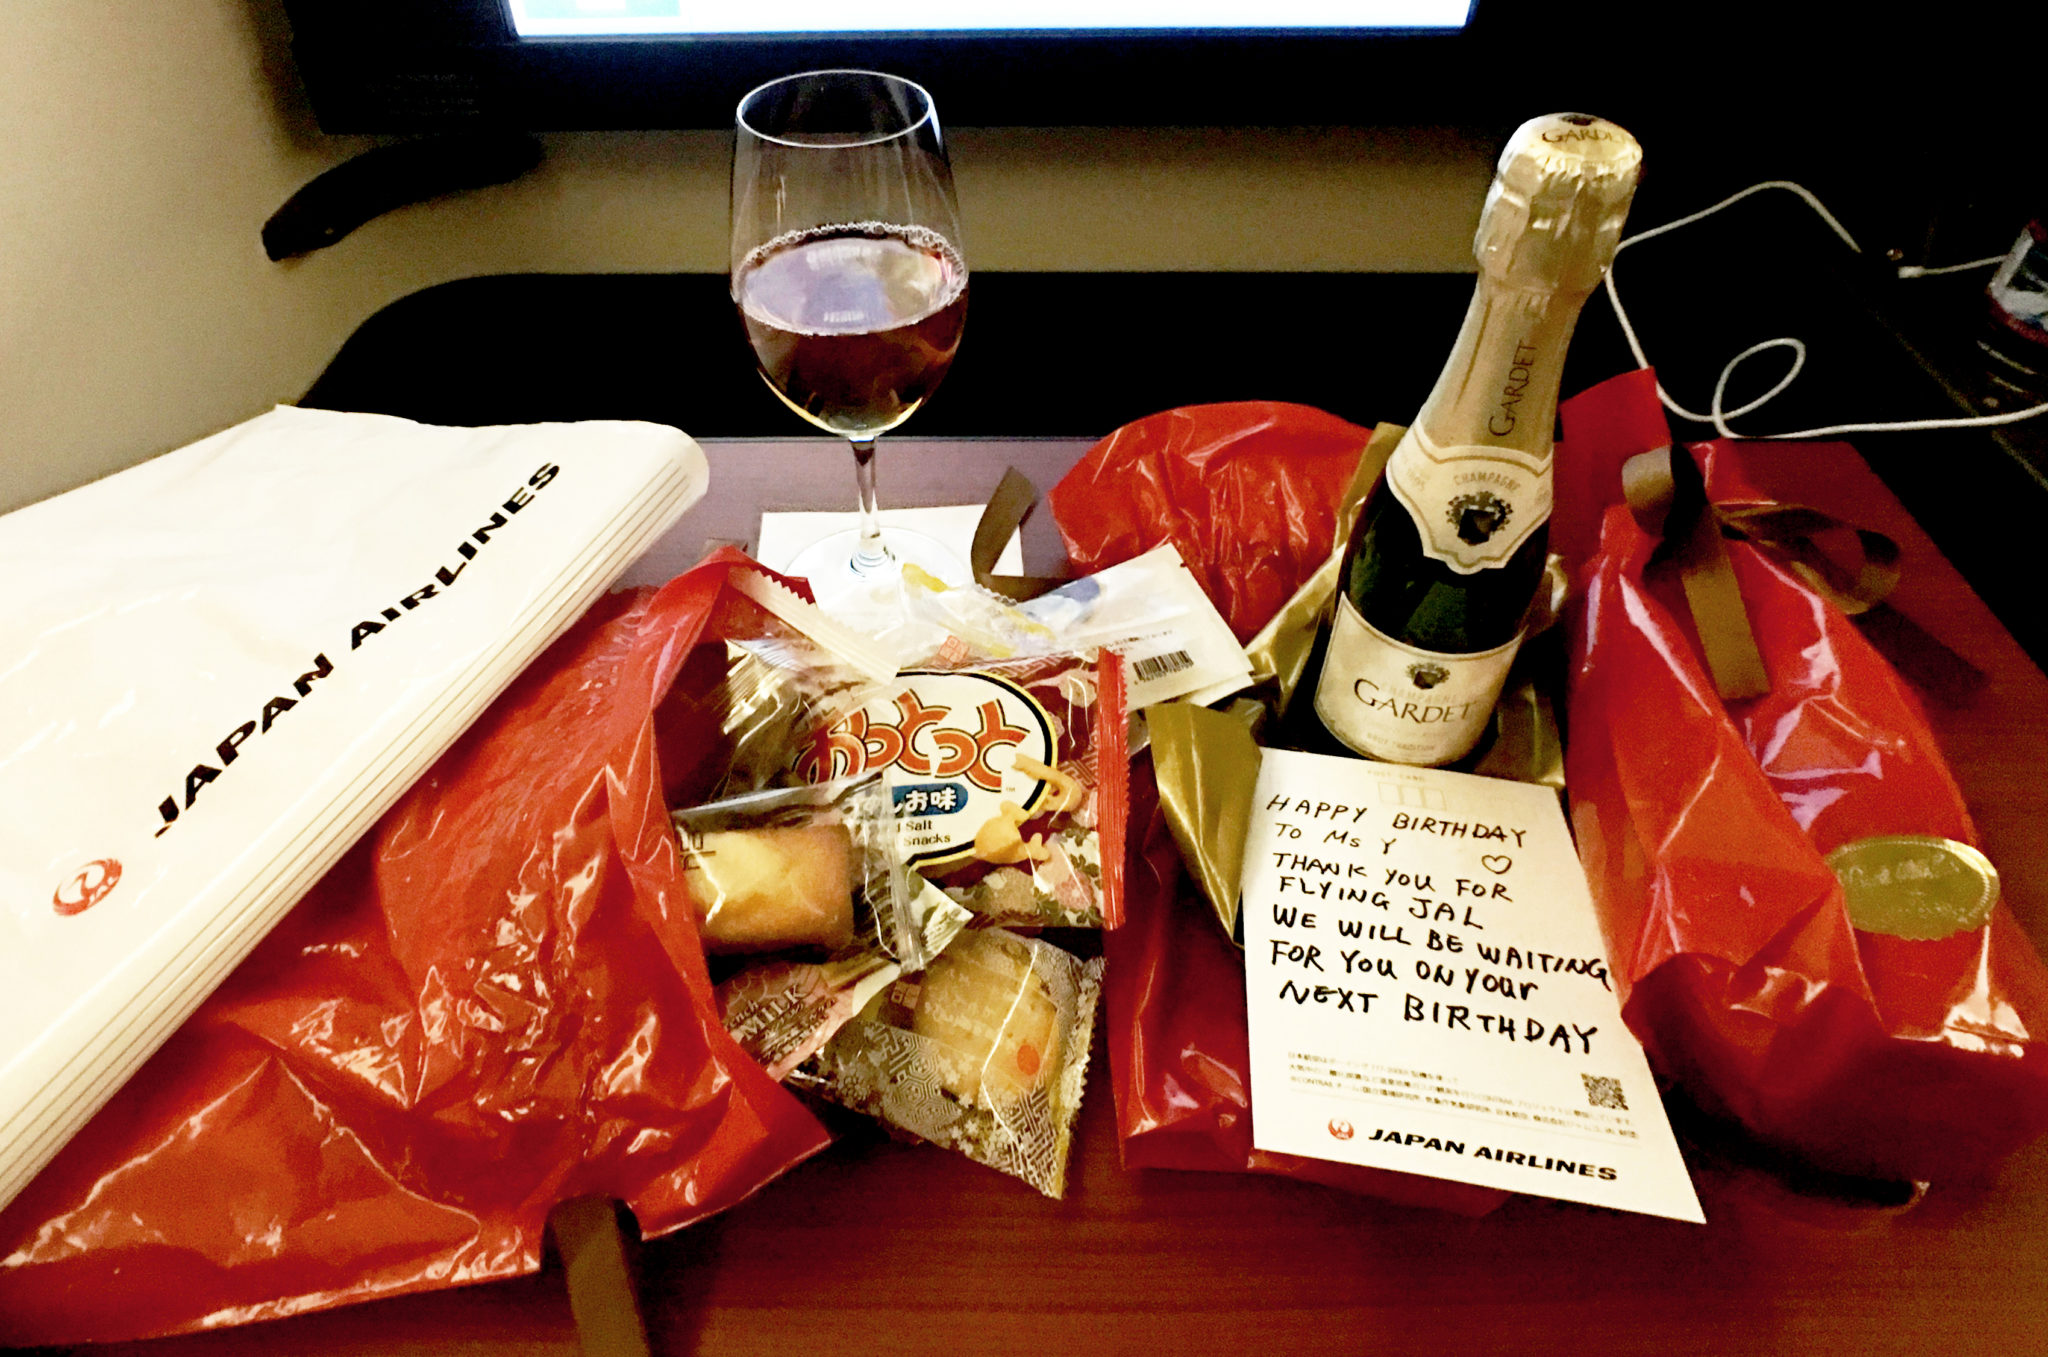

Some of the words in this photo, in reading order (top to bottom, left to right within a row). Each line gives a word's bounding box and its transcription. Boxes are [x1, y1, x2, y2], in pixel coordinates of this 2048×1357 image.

[1488, 339, 1538, 437] GARDET
[1453, 469, 1521, 491] CHAMPAGNE
[155, 652, 334, 838] JAPAN
[351, 462, 560, 651] AIRLINES
[1353, 678, 1478, 724] GARDET
[904, 832, 951, 847] Snacks
[905, 819, 933, 832] Salt
[1265, 794, 1368, 823] HAPPY
[1393, 812, 1527, 848] BIRTHDAY
[1274, 823, 1302, 840] TO
[1380, 837, 1397, 855] Y
[1273, 852, 1367, 878] THANK
[1455, 878, 1513, 902] FOR
[1279, 876, 1389, 910] FLYING
[1408, 897, 1484, 930] JAL
[1270, 939, 1325, 972] FOR
[1415, 960, 1455, 987] ON
[1273, 903, 1317, 929] WE
[1338, 919, 1412, 946] WILL
[1426, 928, 1464, 953] BE
[1477, 942, 1612, 992] WAITING
[725, 1000, 760, 1029] ench
[741, 984, 808, 1041] MILK
[1279, 980, 1379, 1014] NEXT
[1403, 992, 1598, 1055] BIRTHDAY
[1368, 1129, 1465, 1155] JAPAN
[1473, 1146, 1617, 1181] AIRLINES
